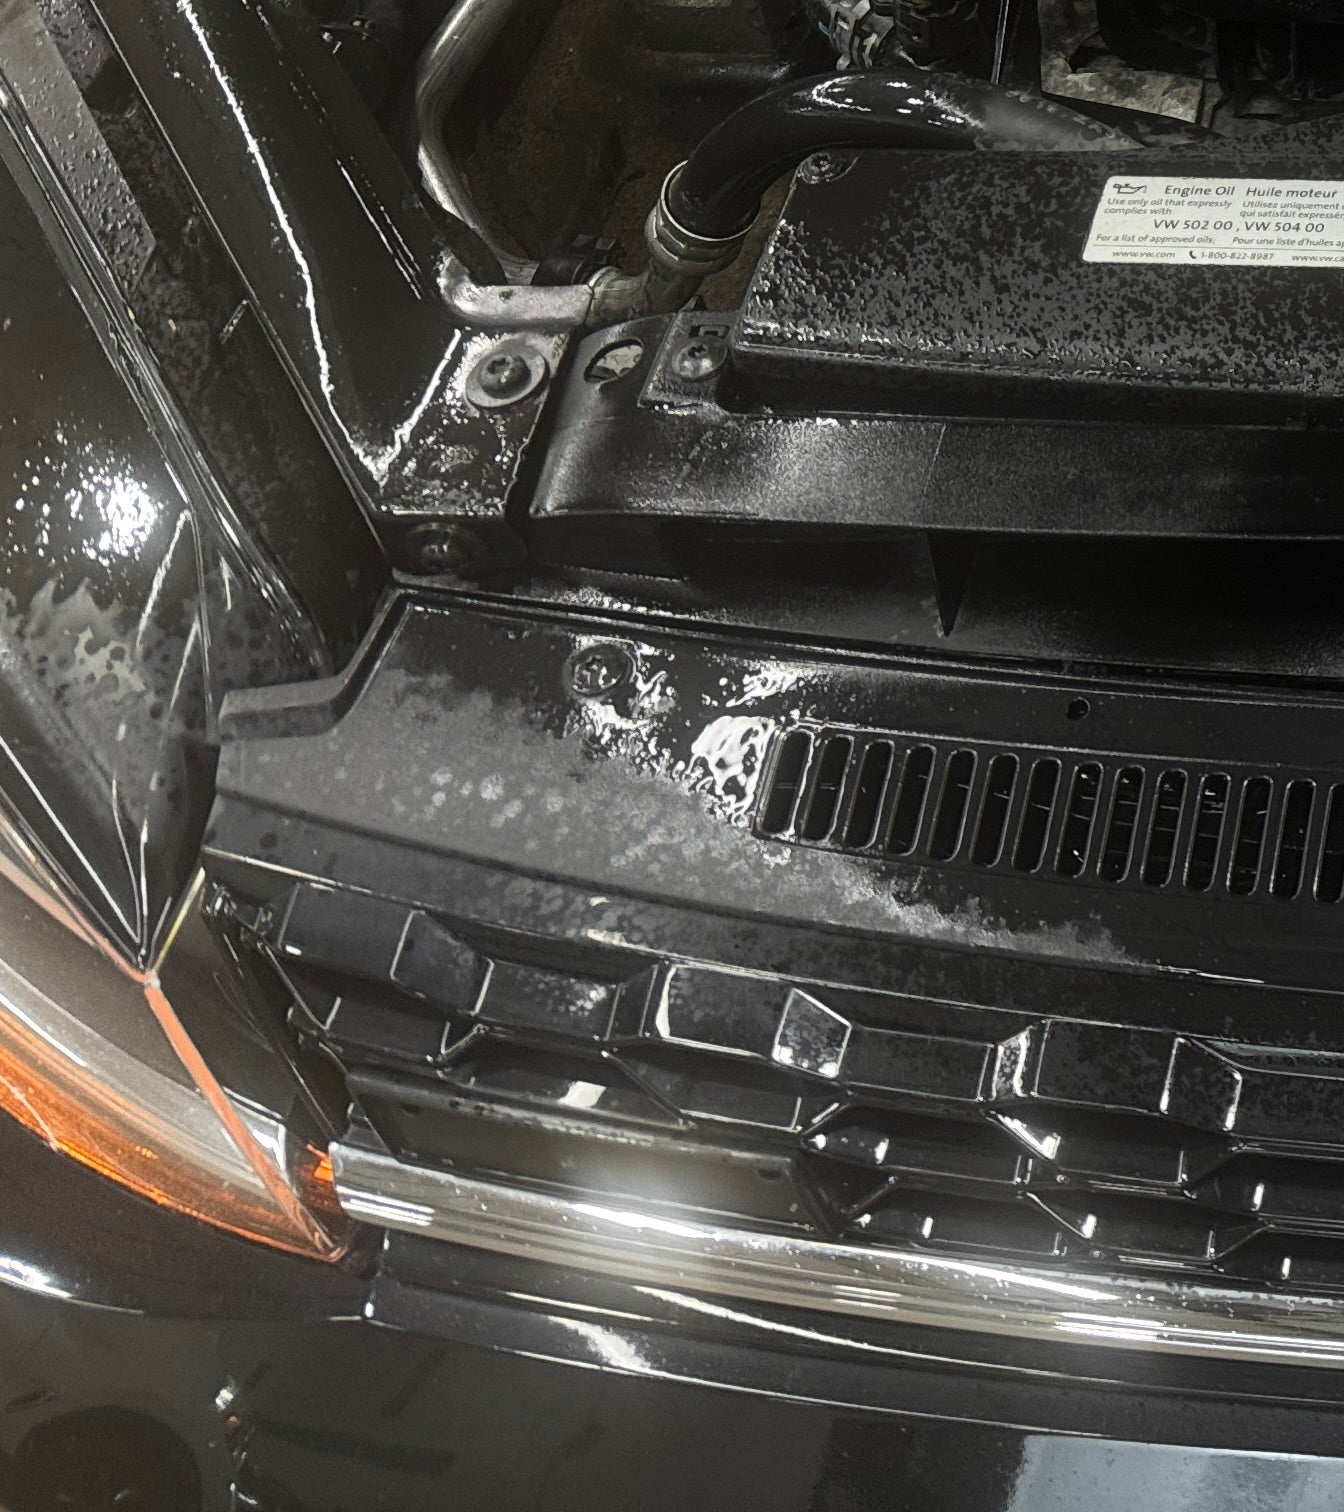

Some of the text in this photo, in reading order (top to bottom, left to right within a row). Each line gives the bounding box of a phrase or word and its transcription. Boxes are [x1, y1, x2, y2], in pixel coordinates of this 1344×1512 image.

[1165, 185, 1235, 197] Engine Oil
[1246, 187, 1337, 199] Huile moteur
[1128, 198, 1148, 207] only
[1187, 199, 1232, 208] expressly
[1242, 200, 1277, 208] Utilisez
[1280, 202, 1339, 211] uniquement
[1104, 207, 1147, 216] complies
[1239, 210, 1255, 218] qui
[1258, 210, 1295, 218] satisfait
[1154, 219, 1179, 229] VW
[1182, 220, 1209, 230] 502
[1213, 221, 1233, 230] 00
[1245, 221, 1271, 231] VW
[1274, 222, 1300, 232] 504
[1305, 223, 1325, 232] 00
[1122, 234, 1135, 242] list
[1150, 235, 1194, 244] approved
